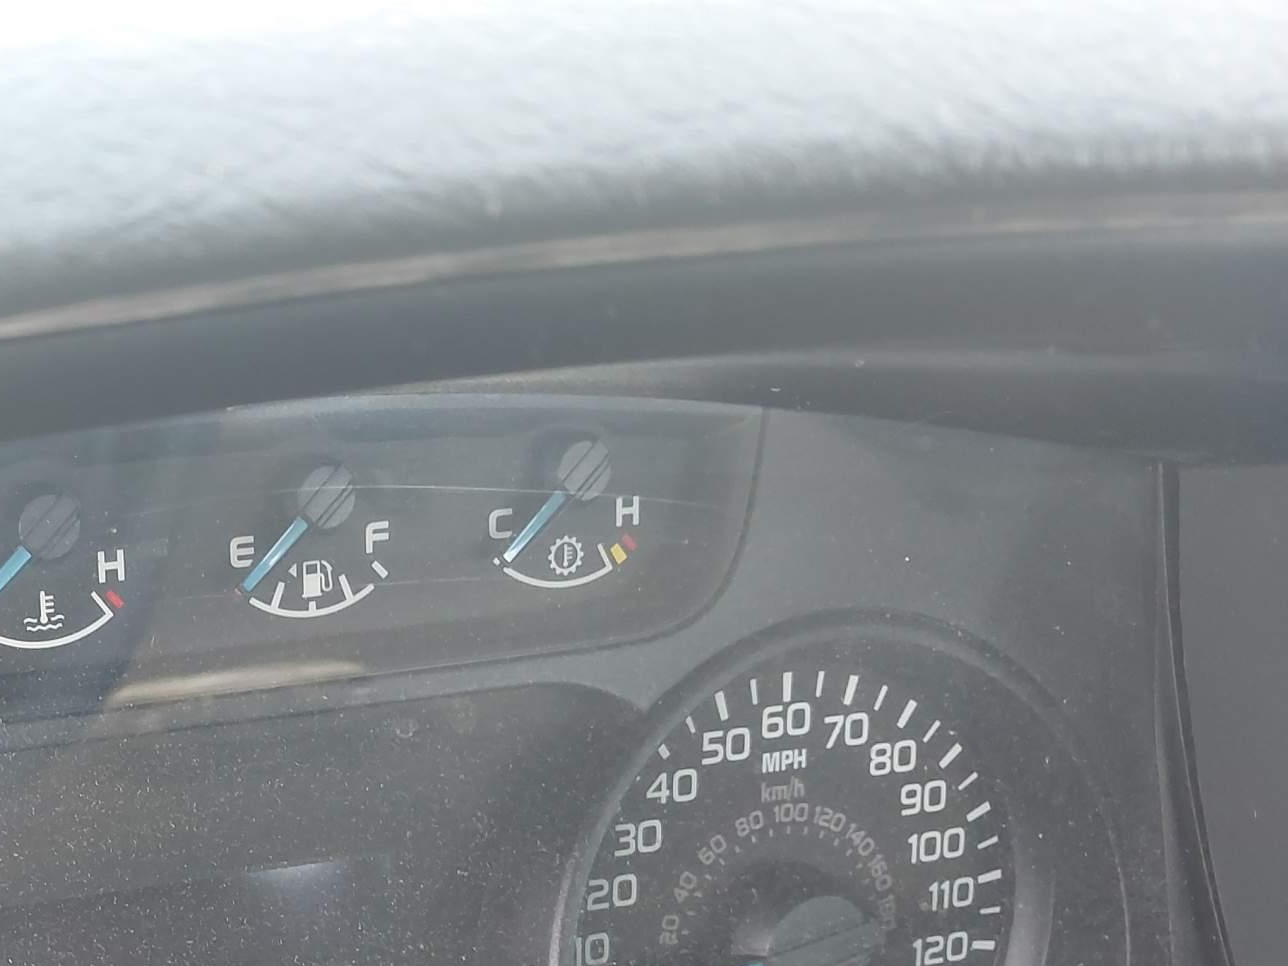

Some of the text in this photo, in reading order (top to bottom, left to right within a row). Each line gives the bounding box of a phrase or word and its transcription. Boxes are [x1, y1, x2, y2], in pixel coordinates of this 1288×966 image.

[488, 508, 513, 539] C
[615, 495, 640, 527] H
[229, 535, 255, 569] E
[365, 520, 390, 554] F
[96, 549, 127, 584] H
[761, 702, 811, 739] 60
[823, 711, 870, 749] 70
[701, 727, 752, 766] 50
[761, 748, 808, 775] MPH
[869, 739, 918, 777] 80
[646, 768, 698, 804] 40
[760, 776, 806, 803] km/h
[899, 780, 947, 816] 90
[735, 811, 765, 837] 80
[773, 803, 809, 823] 100
[814, 806, 847, 833] 120
[614, 819, 663, 857] 30
[697, 834, 728, 865] 60
[847, 823, 875, 857] 140
[907, 827, 966, 864] 100
[586, 873, 638, 912] 20
[673, 870, 698, 903] 40
[928, 876, 975, 911] 110
[575, 932, 610, 966] 10
